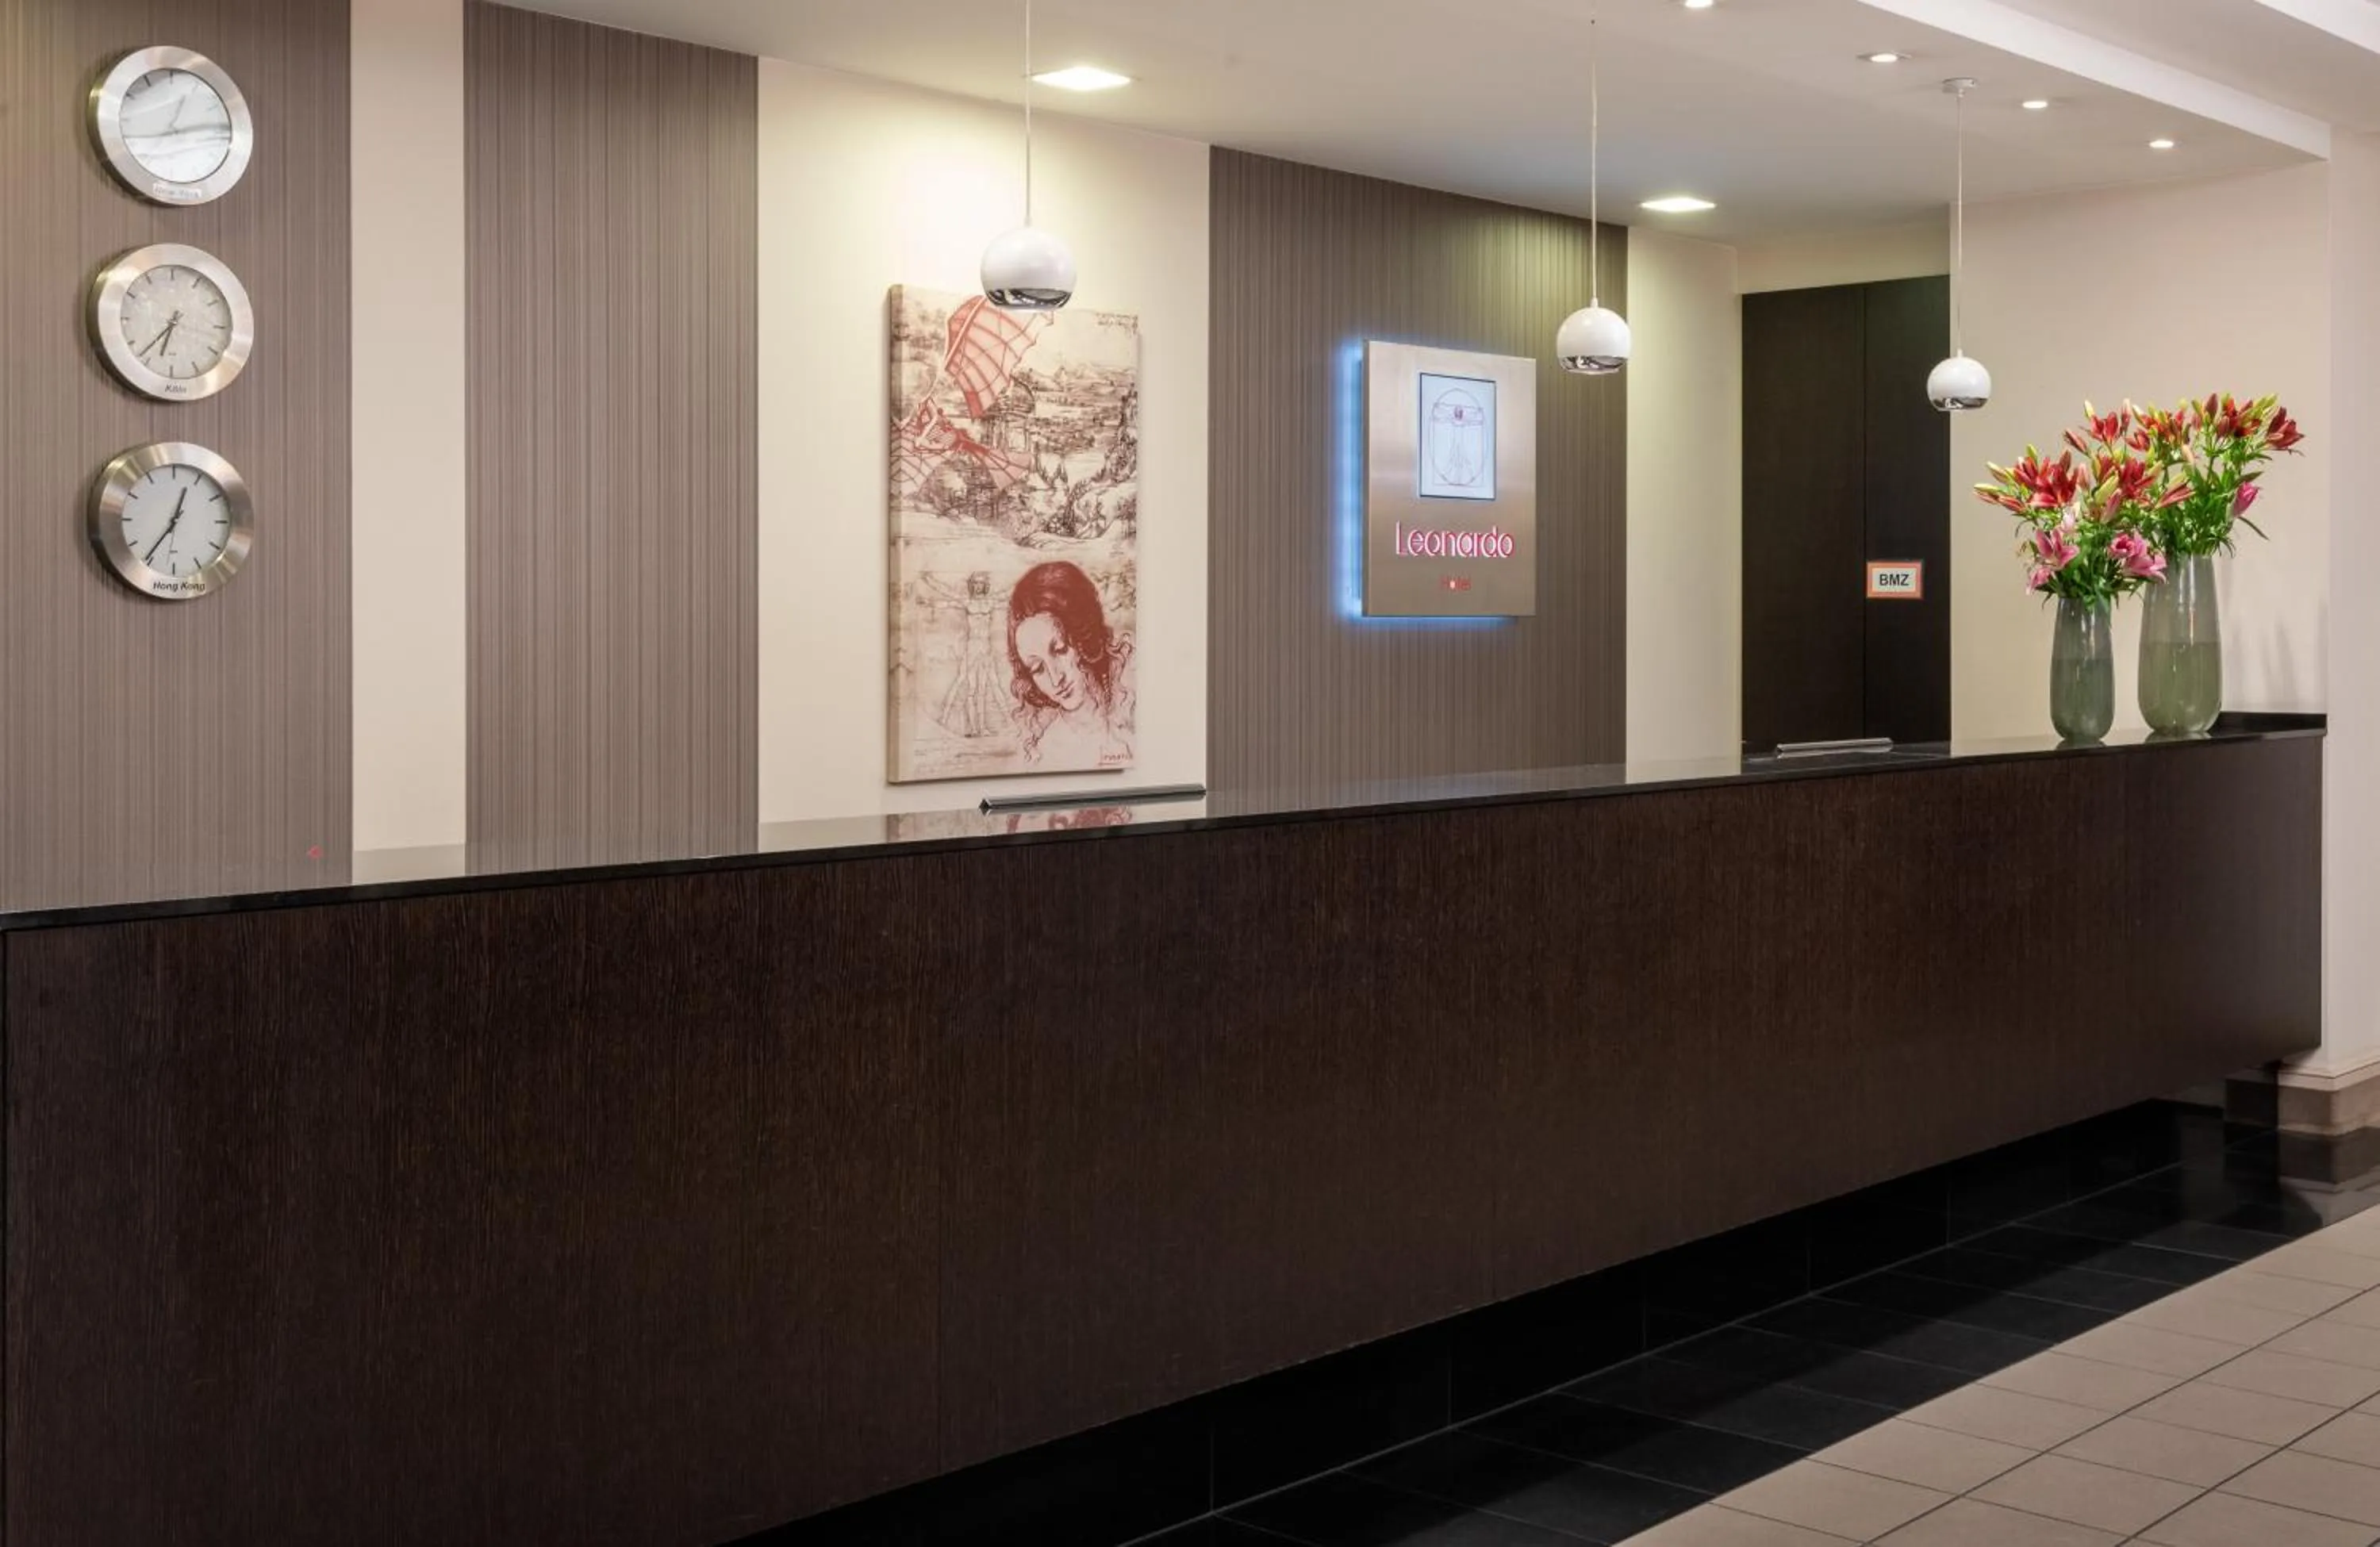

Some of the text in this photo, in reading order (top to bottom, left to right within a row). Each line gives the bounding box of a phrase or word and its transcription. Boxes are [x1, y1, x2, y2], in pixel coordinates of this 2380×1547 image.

[1395, 520, 1514, 558] Leonardo
[1879, 574, 1910, 586] BMZ
[153, 582, 205, 593] Hong Kong
